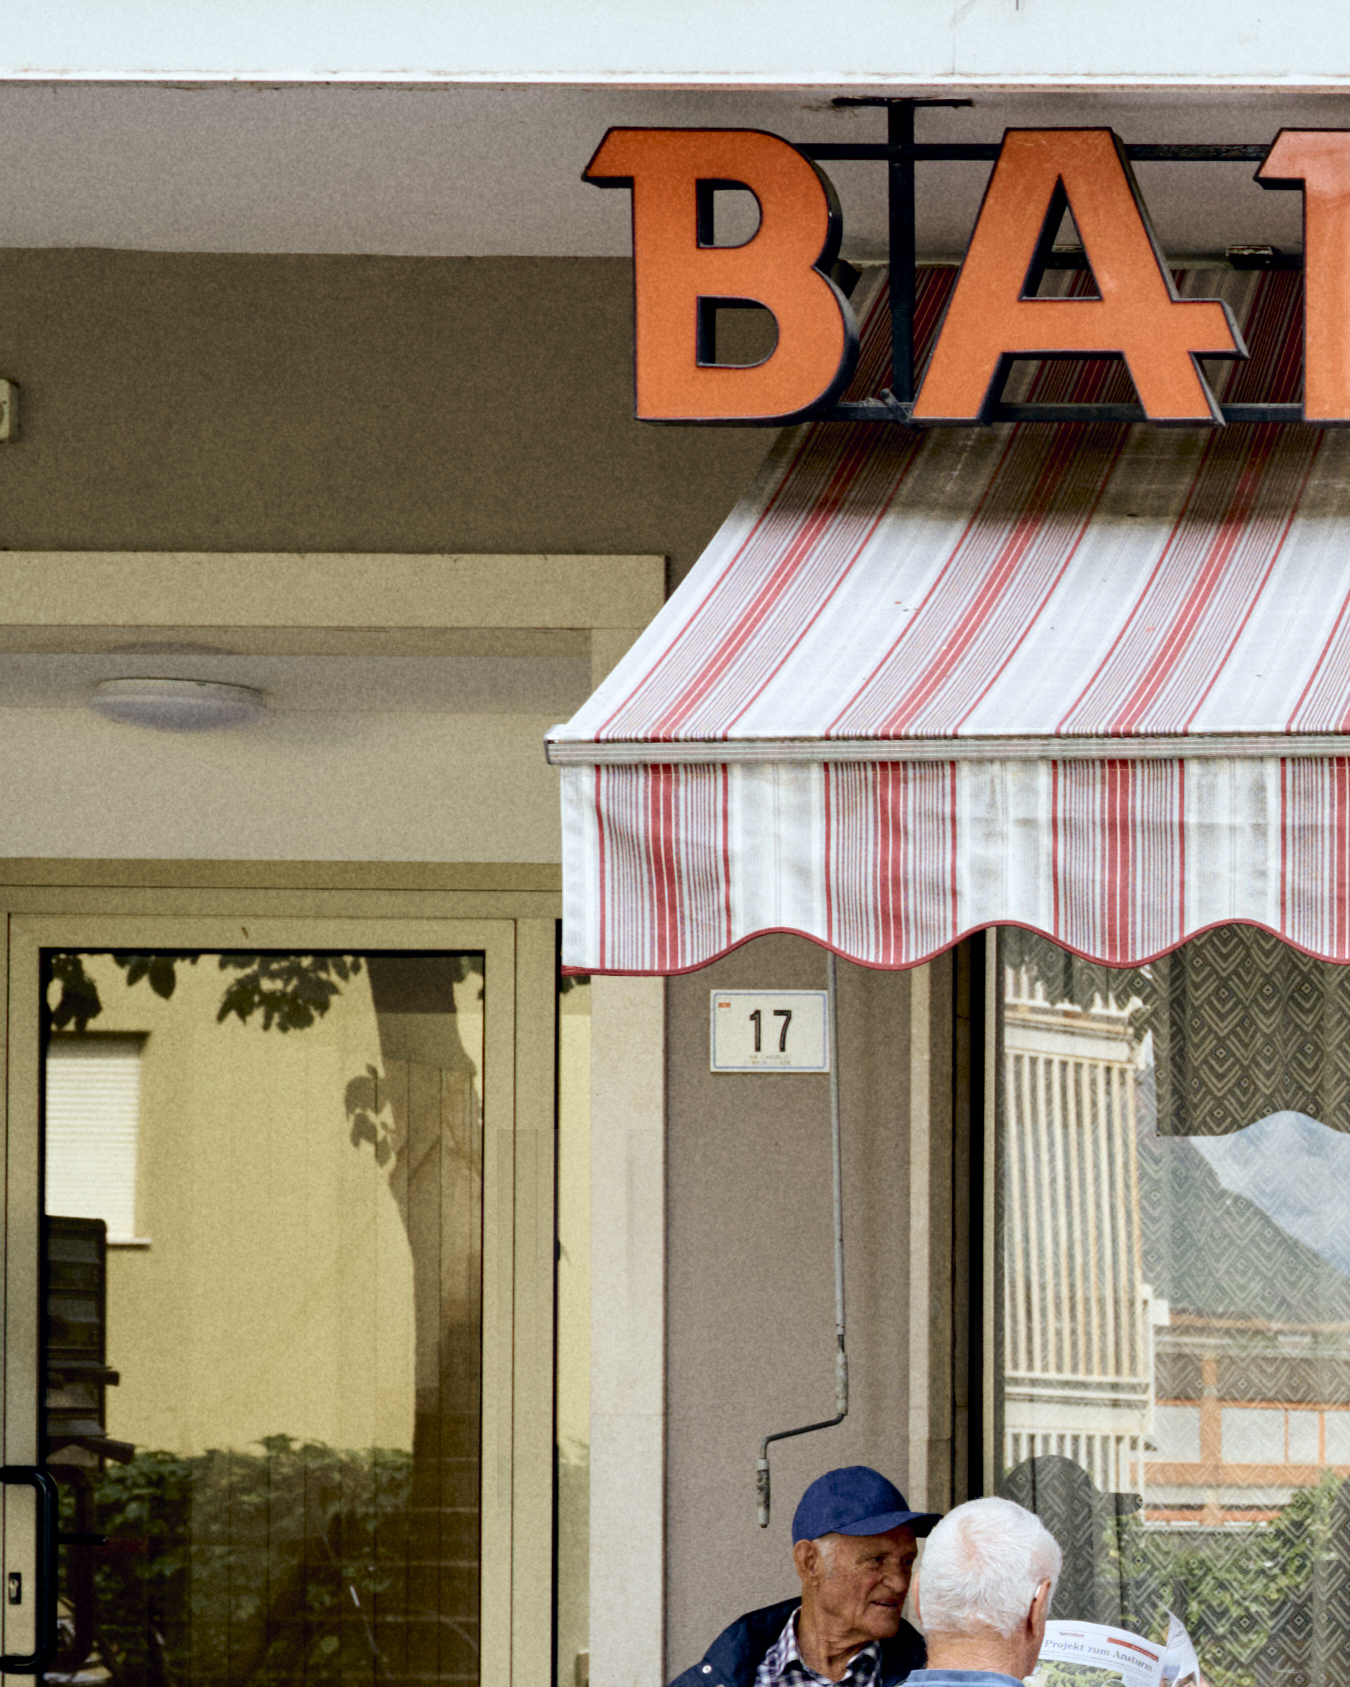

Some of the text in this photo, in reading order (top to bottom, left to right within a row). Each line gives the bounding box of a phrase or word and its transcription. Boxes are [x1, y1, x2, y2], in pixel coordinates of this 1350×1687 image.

[749, 1009, 792, 1053] 17
[1044, 1639, 1084, 1651] Projekt
[1087, 1646, 1110, 1656] zum
[1112, 1650, 1153, 1672] Ansturm
